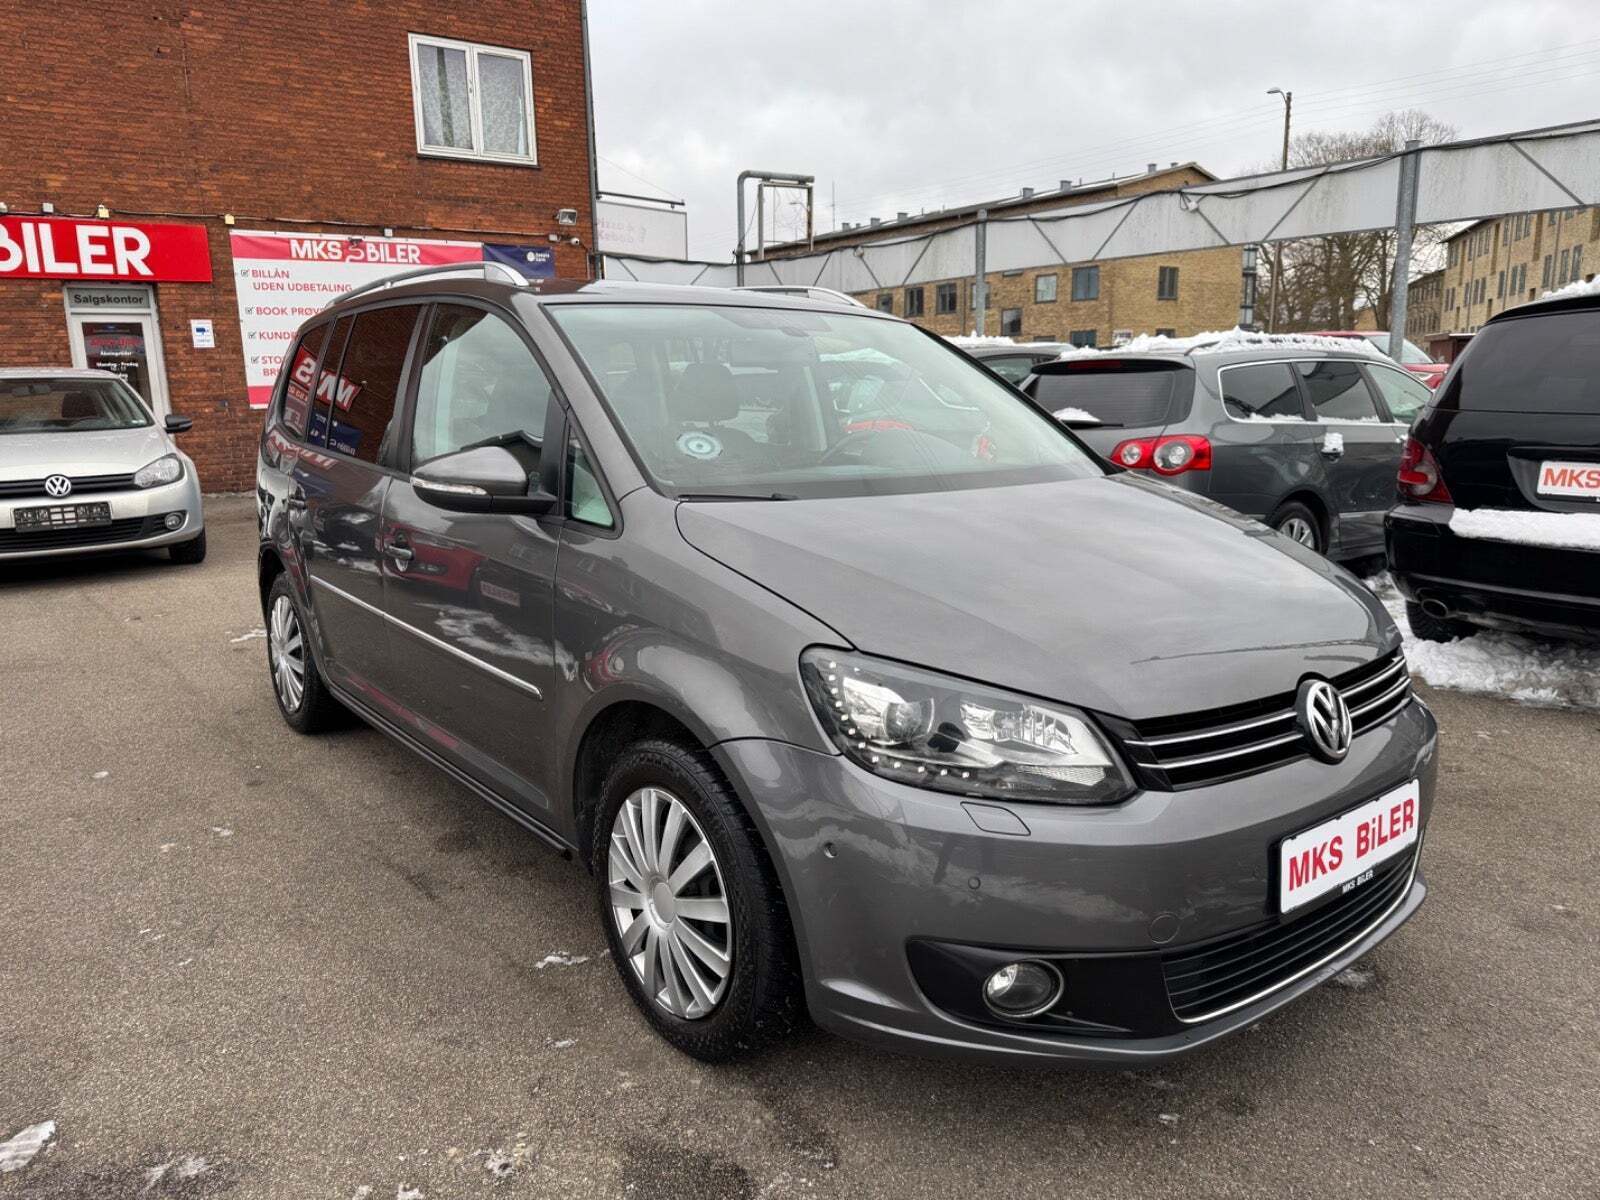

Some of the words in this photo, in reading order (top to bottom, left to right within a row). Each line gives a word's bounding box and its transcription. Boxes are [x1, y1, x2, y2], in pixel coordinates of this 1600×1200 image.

[289, 239, 343, 260] MKS
[365, 242, 421, 264] BILER
[251, 267, 290, 279] BILLÅN
[253, 281, 284, 291] UDEN
[287, 282, 353, 293] UDBETALING
[74, 294, 144, 306] Salgskontor
[255, 306, 289, 316] BOOK
[1543, 467, 1600, 489] MKS
[1288, 835, 1343, 892] MKS
[1342, 880, 1356, 894] MKS
